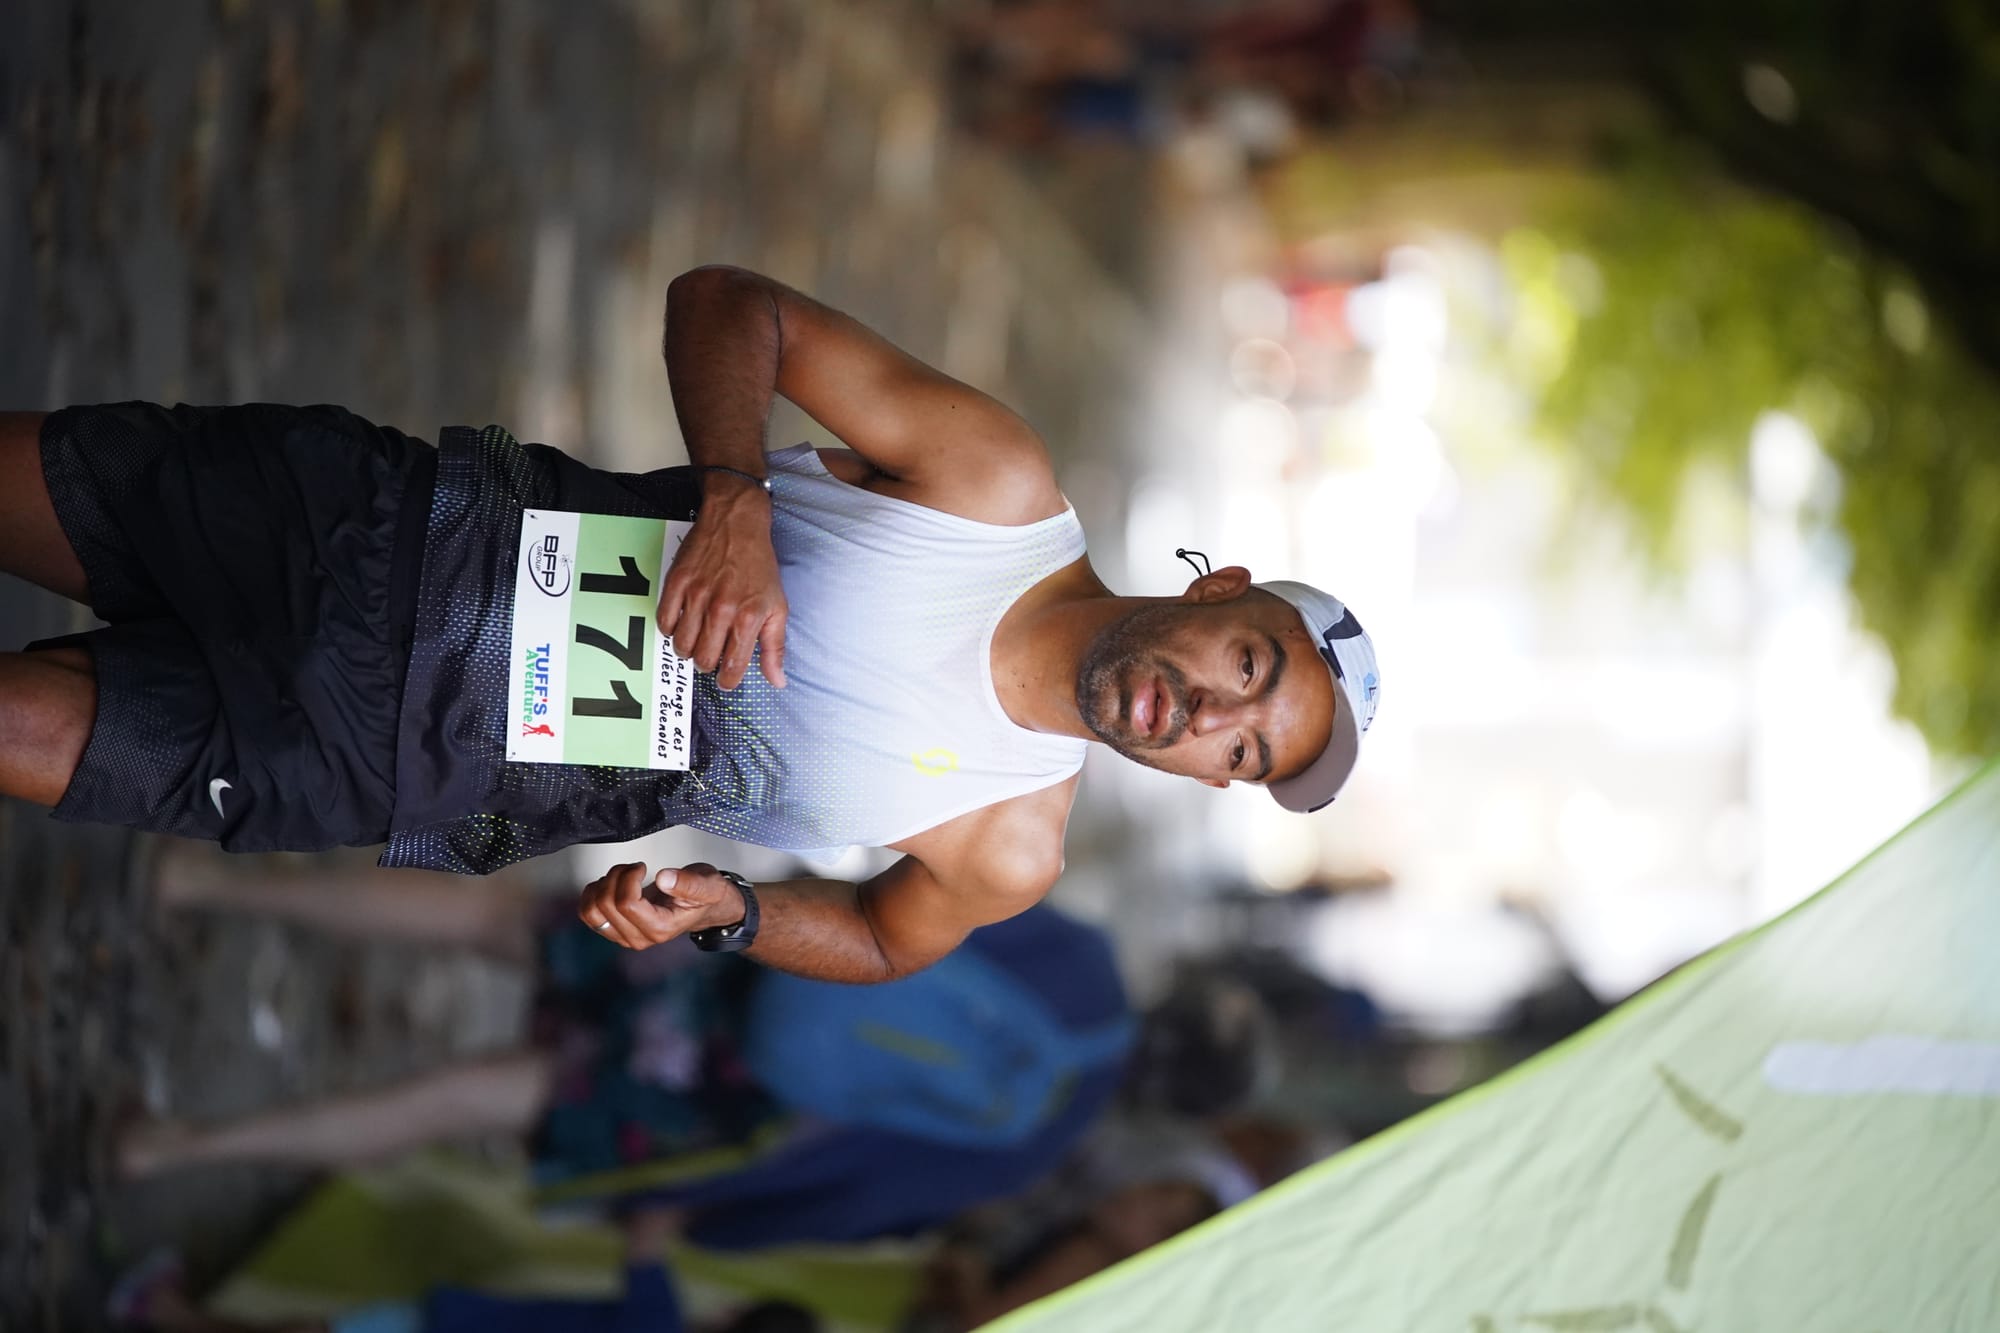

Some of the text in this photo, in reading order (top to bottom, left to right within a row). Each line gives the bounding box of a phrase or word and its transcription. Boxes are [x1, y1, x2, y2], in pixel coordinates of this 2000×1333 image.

[535, 546, 543, 572] GROUP
[541, 535, 559, 587] BFP
[572, 555, 651, 720] 171
[523, 648, 539, 723] Aventure
[533, 643, 550, 716] TUFF'S
[671, 658, 688, 752] allenge des
[658, 694, 671, 759] cévenoles
